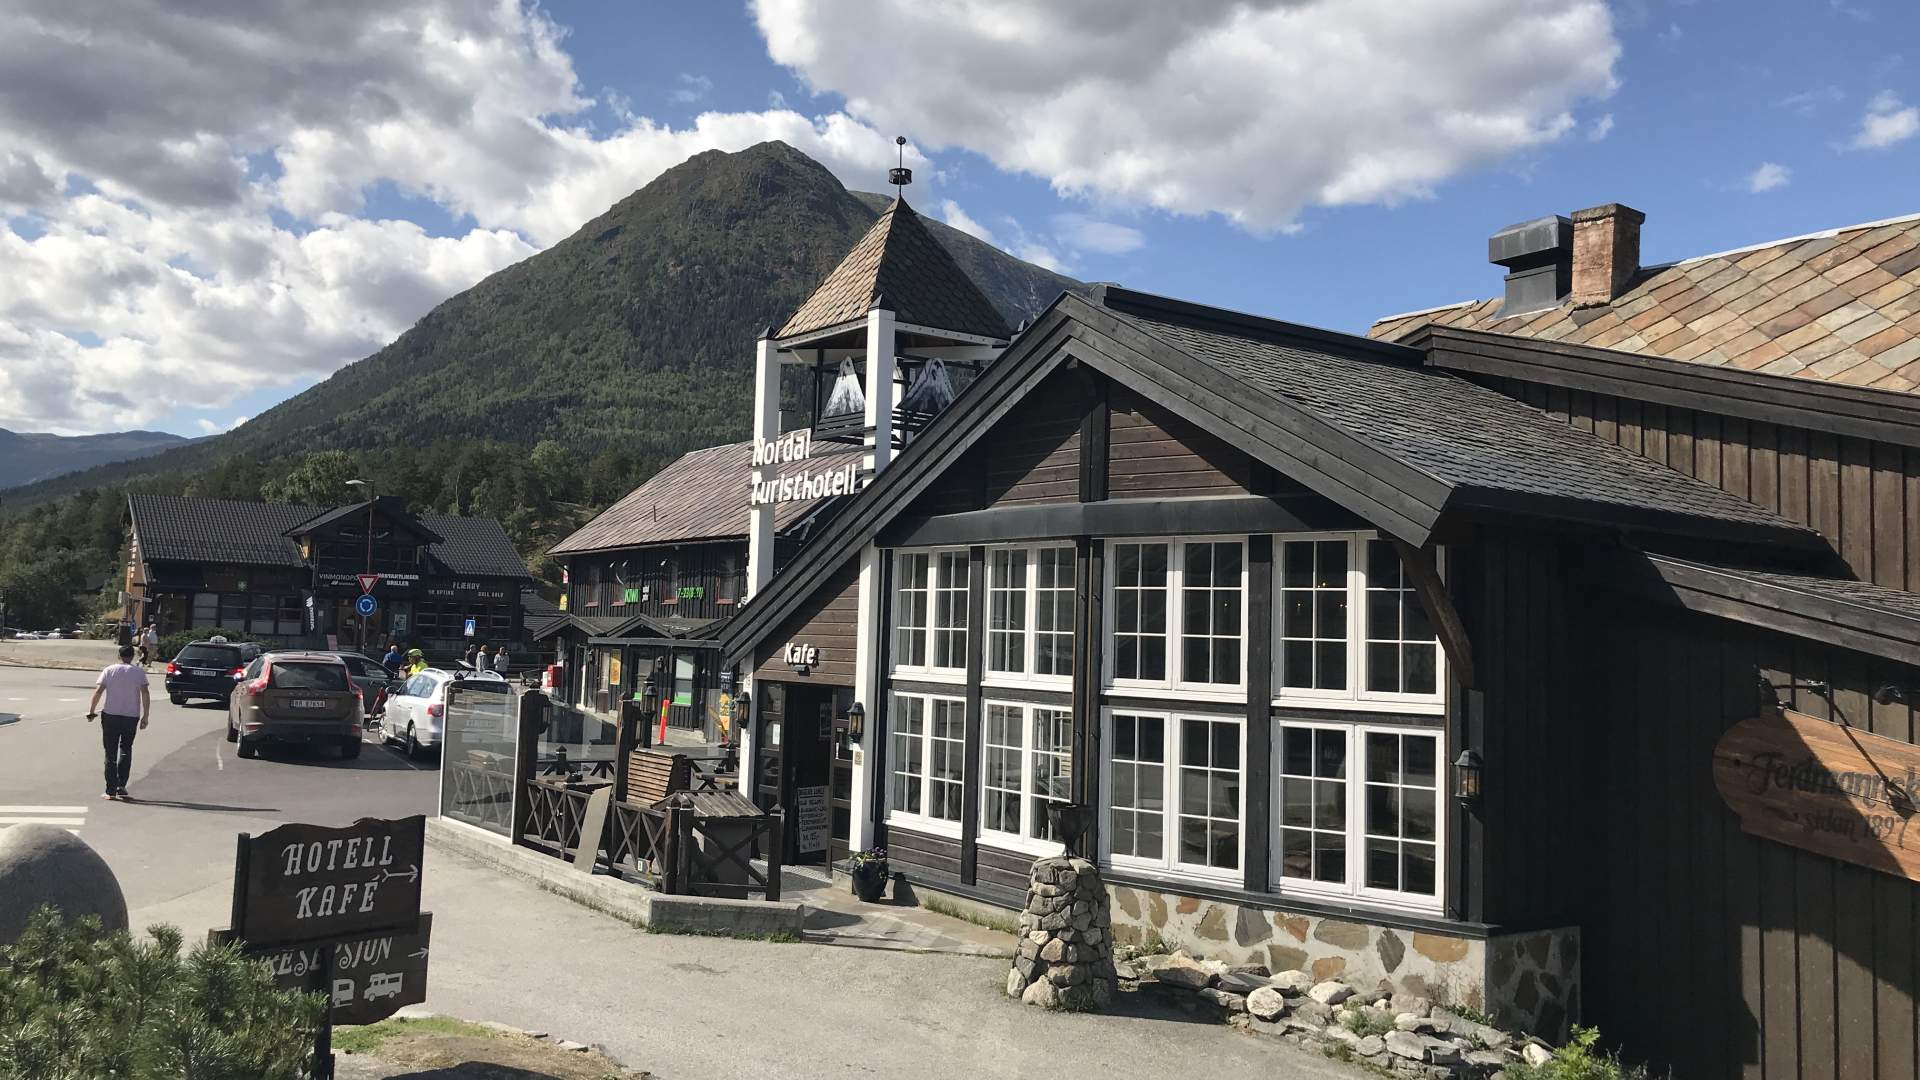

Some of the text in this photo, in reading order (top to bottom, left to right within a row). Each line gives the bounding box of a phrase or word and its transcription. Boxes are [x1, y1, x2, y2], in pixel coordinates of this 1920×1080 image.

[752, 428, 811, 466] Nordal
[752, 464, 856, 505] Turisthotell
[319, 573, 359, 581] VINMONOPO
[624, 589, 639, 603] KIWI
[783, 642, 815, 664] Kafe
[281, 836, 393, 876] HOTELL
[296, 875, 380, 919] KAFÉ
